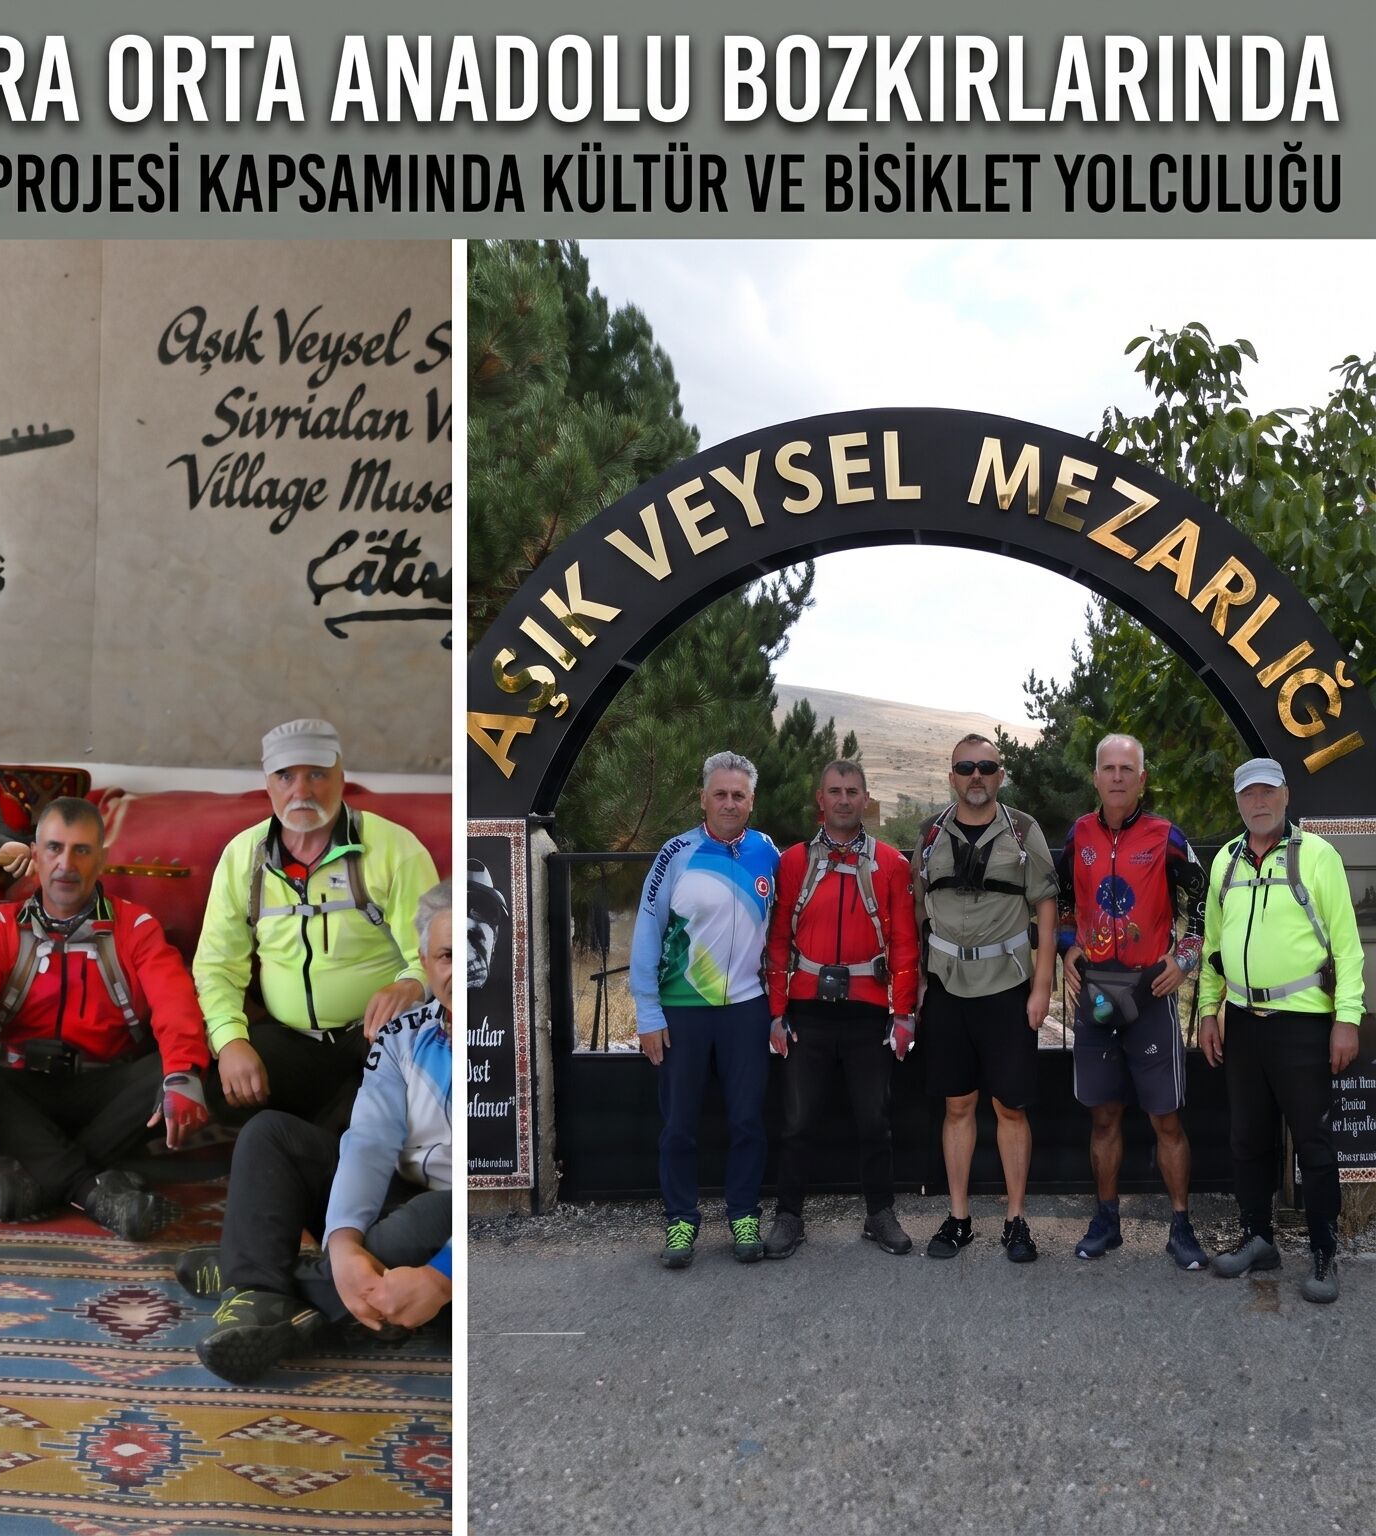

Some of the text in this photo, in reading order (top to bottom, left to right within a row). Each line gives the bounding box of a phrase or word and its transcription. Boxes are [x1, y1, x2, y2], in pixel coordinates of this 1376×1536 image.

[157, 304, 266, 376] Aşık
[273, 305, 413, 389] Veysel
[201, 382, 414, 447] Sivrialan
[165, 451, 330, 535] Village
[467, 429, 1366, 780] AŞIK VEYSEL MEZARLIĞI
